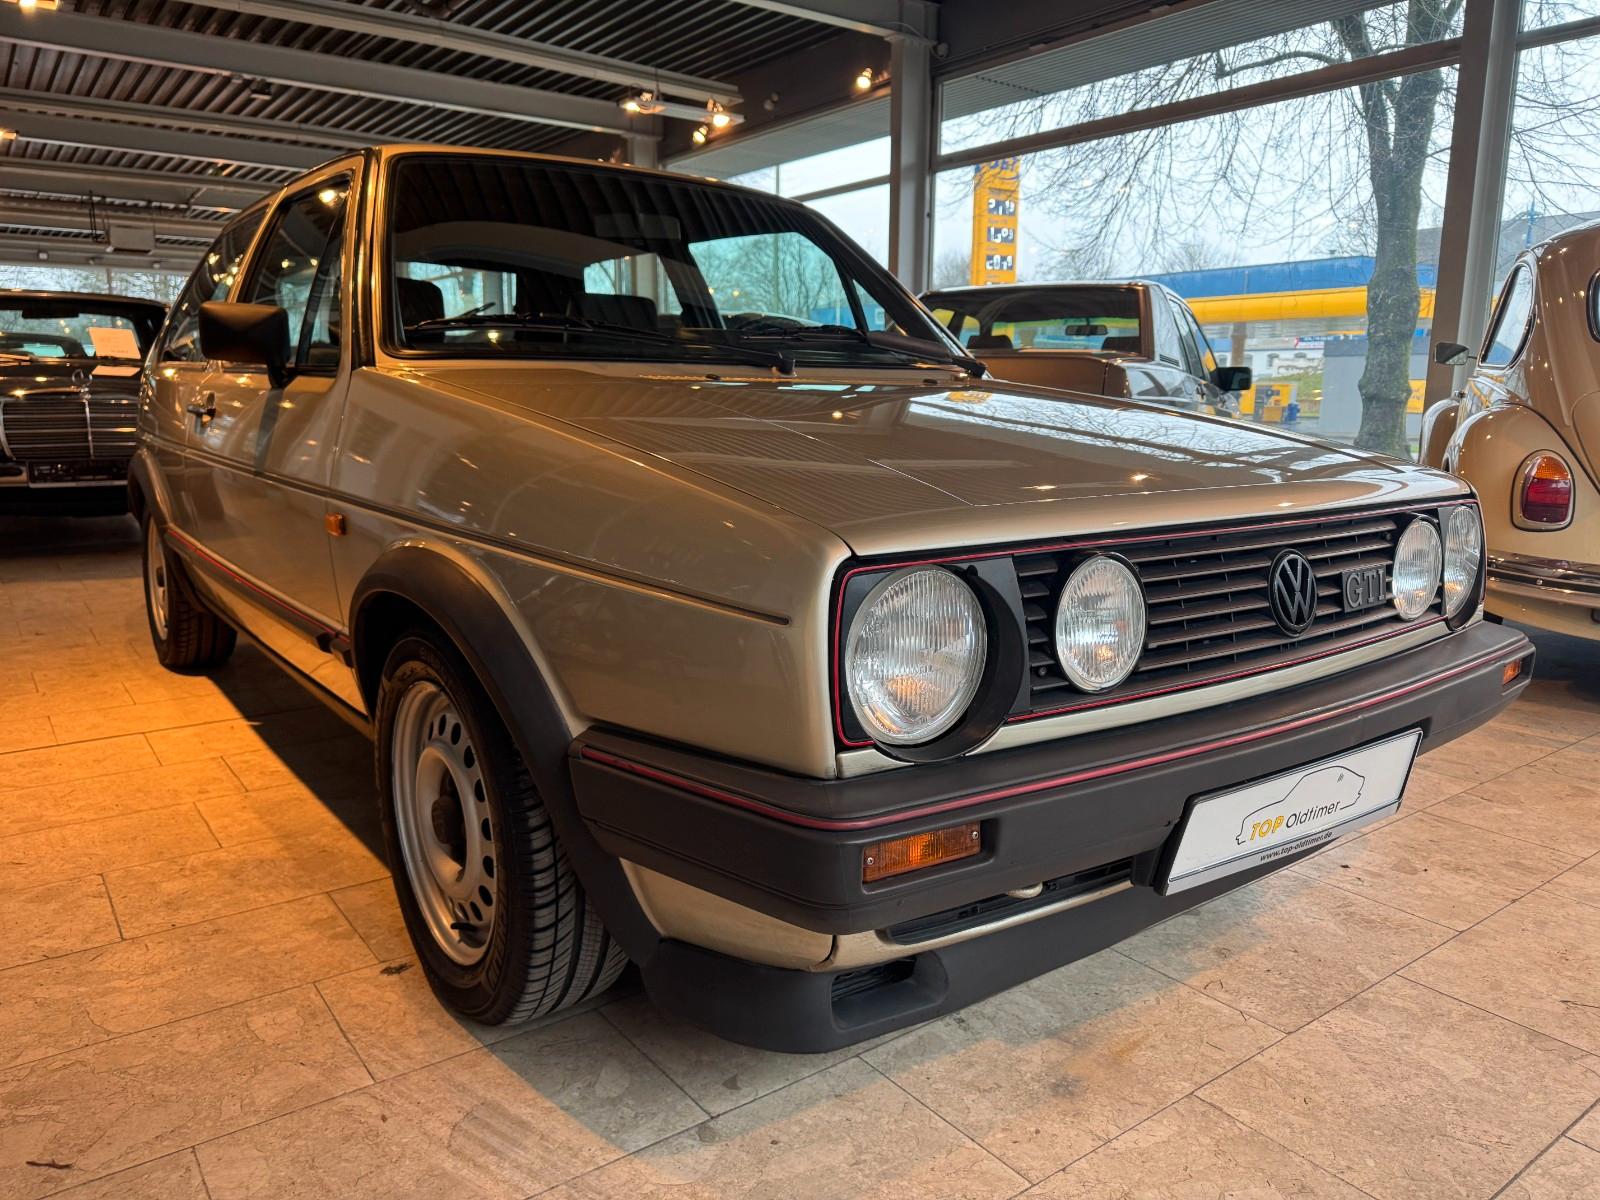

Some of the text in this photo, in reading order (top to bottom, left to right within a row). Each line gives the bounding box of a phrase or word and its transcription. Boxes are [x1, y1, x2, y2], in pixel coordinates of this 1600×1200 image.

[1273, 552, 1314, 629] VW
[1346, 568, 1385, 608] GTI
[1250, 801, 1341, 841] TOP Oldtimer
[1260, 831, 1333, 861] www.top-oldtimer.de
